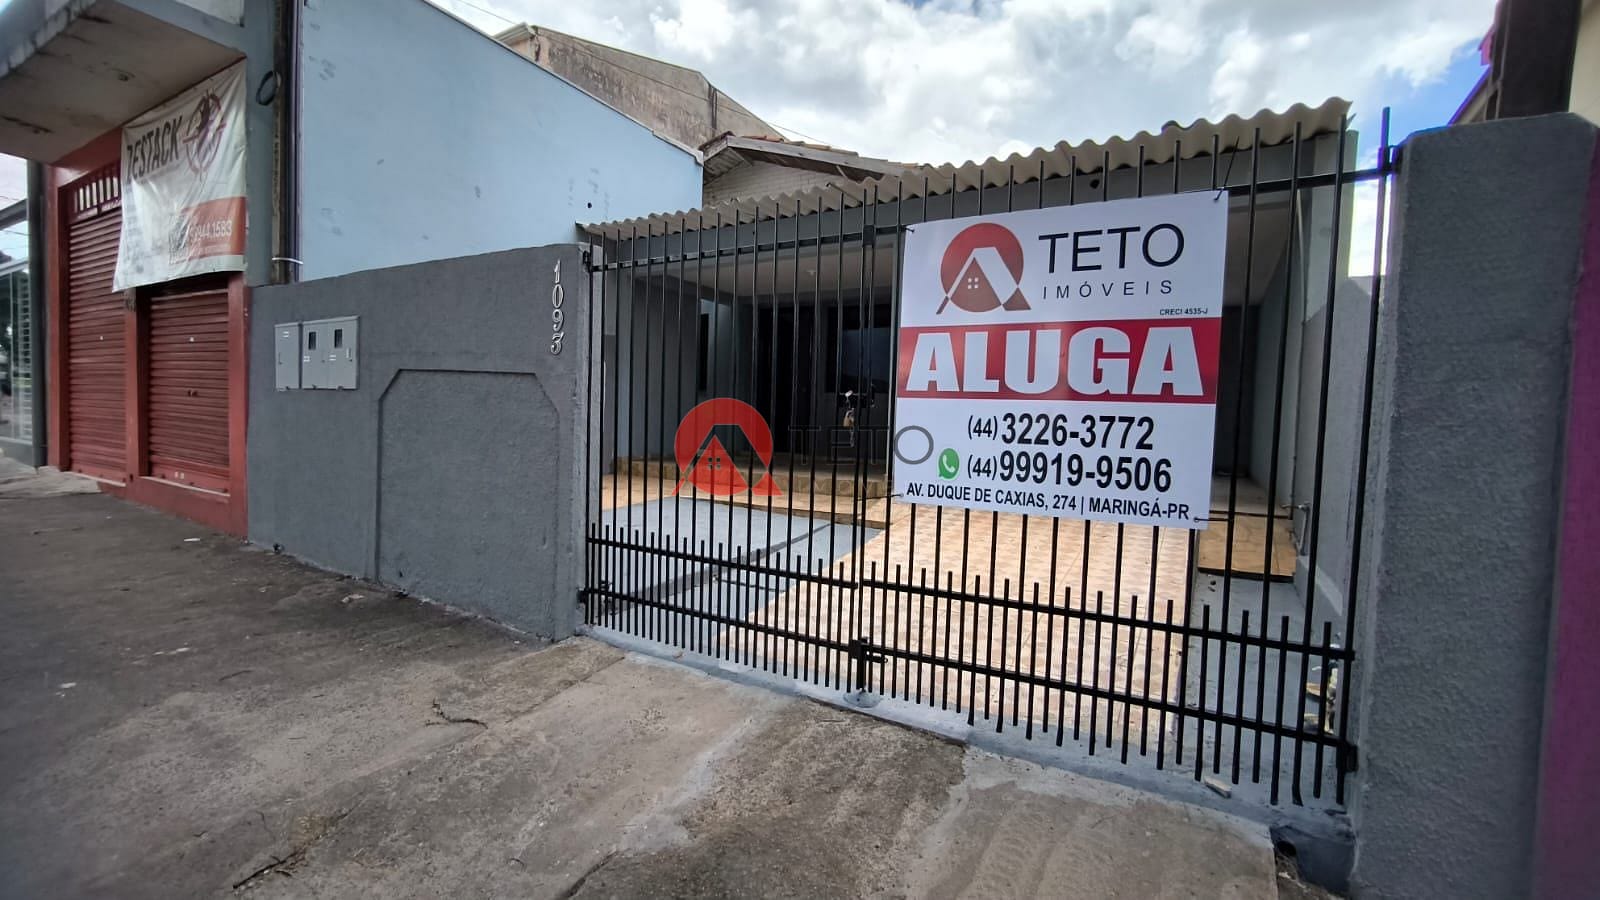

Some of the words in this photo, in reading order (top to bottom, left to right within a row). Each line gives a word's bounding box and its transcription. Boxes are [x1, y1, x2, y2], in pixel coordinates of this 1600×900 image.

[1038, 223, 1185, 274] TETO
[550, 259, 564, 355] 1093
[1043, 280, 1173, 299] IMÓVEIS
[905, 326, 1204, 396] ALUGA
[906, 482, 924, 497] AV.
[927, 484, 971, 501] DUQUE
[974, 488, 992, 503] DE
[995, 490, 1049, 511] CAXIAS,
[1052, 494, 1077, 511] 274
[1088, 497, 1190, 520] MARINGÁ-PR
